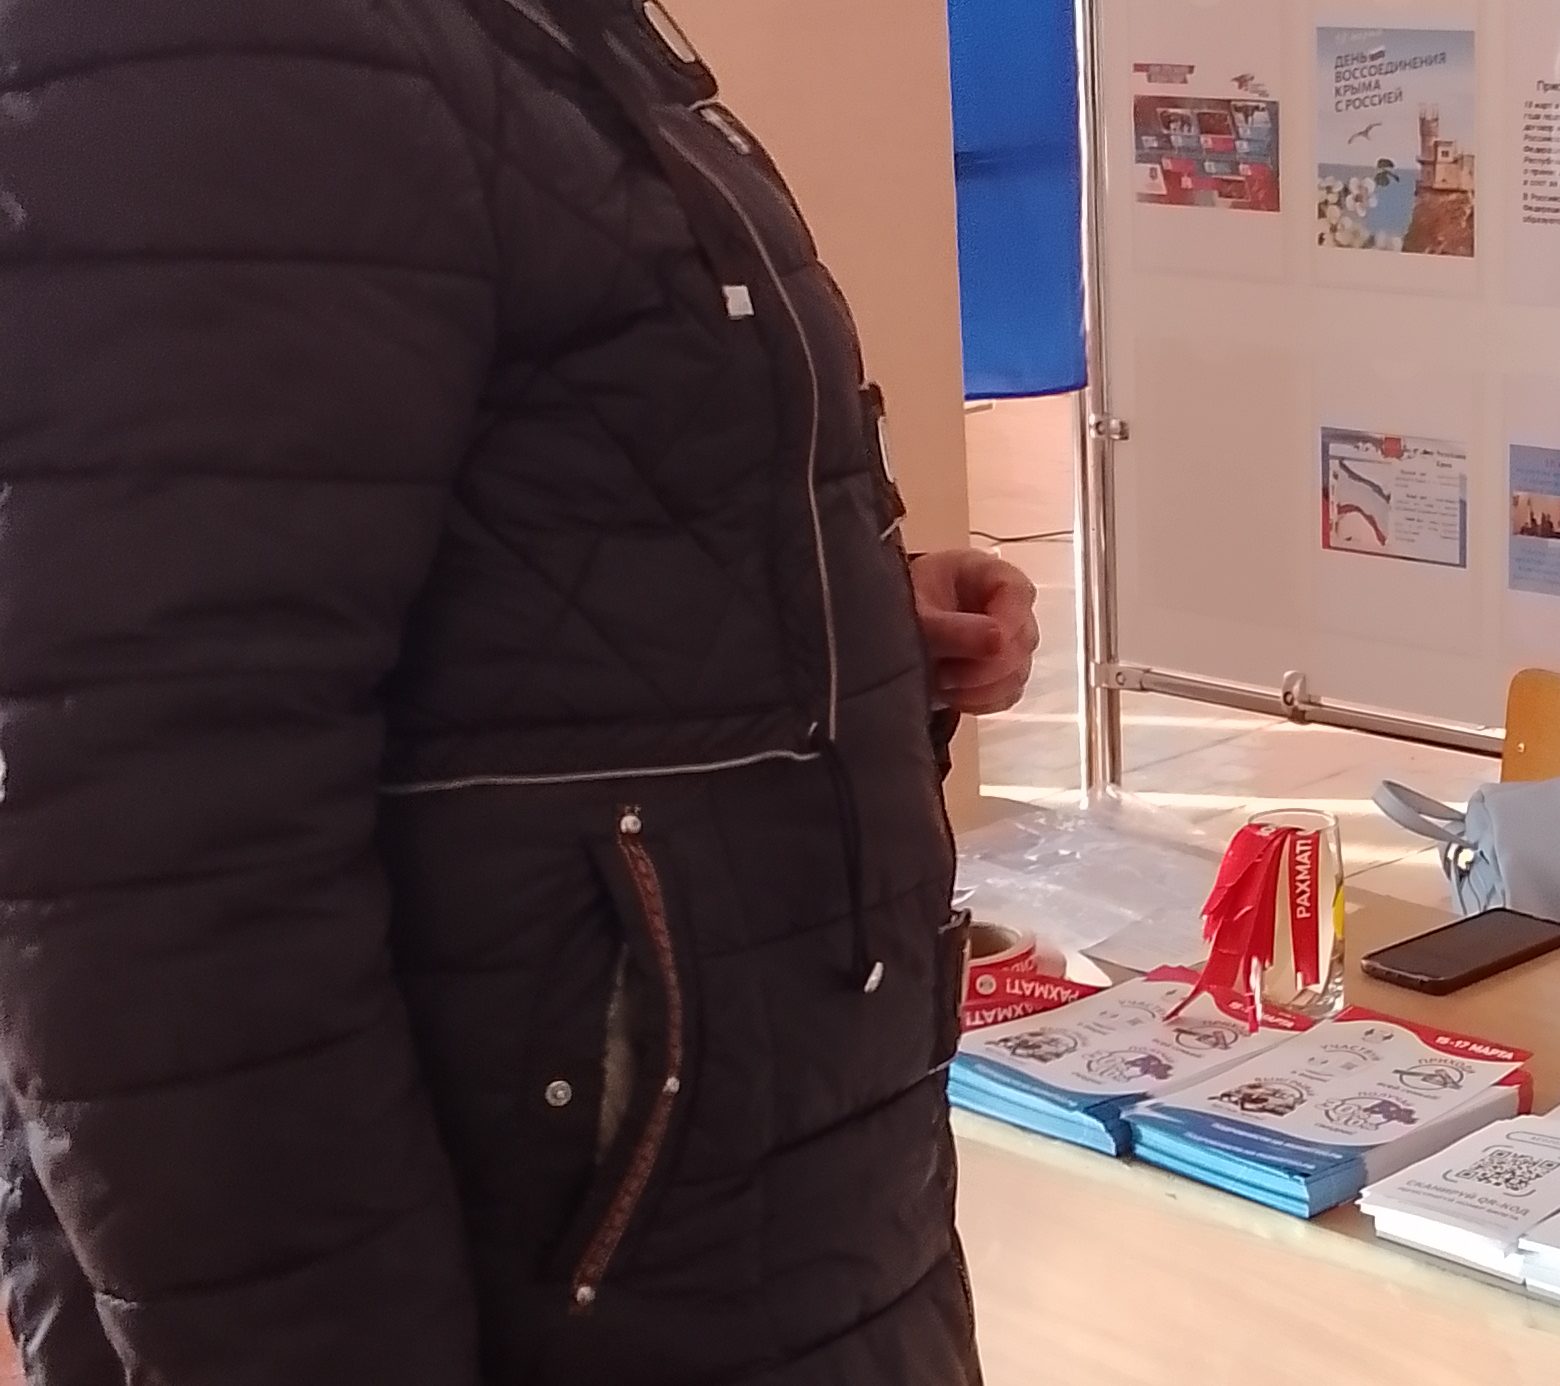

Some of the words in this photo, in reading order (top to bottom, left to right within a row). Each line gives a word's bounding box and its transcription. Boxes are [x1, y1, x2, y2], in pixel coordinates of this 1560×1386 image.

[1334, 51, 1447, 84] ВОССОЕДИНЕНИЯ
[1335, 52, 1367, 70] ДЕНЬ
[1334, 79, 1381, 98] КРЫМА
[1335, 100, 1344, 113] С
[1345, 87, 1403, 112] РОССИЕЙ
[1435, 1035, 1470, 1051] 15-17
[1468, 1043, 1515, 1061] МАРТА
[1405, 1178, 1477, 1202] СКАНИРУЙ
[1476, 1194, 1531, 1218] QR-КОД
